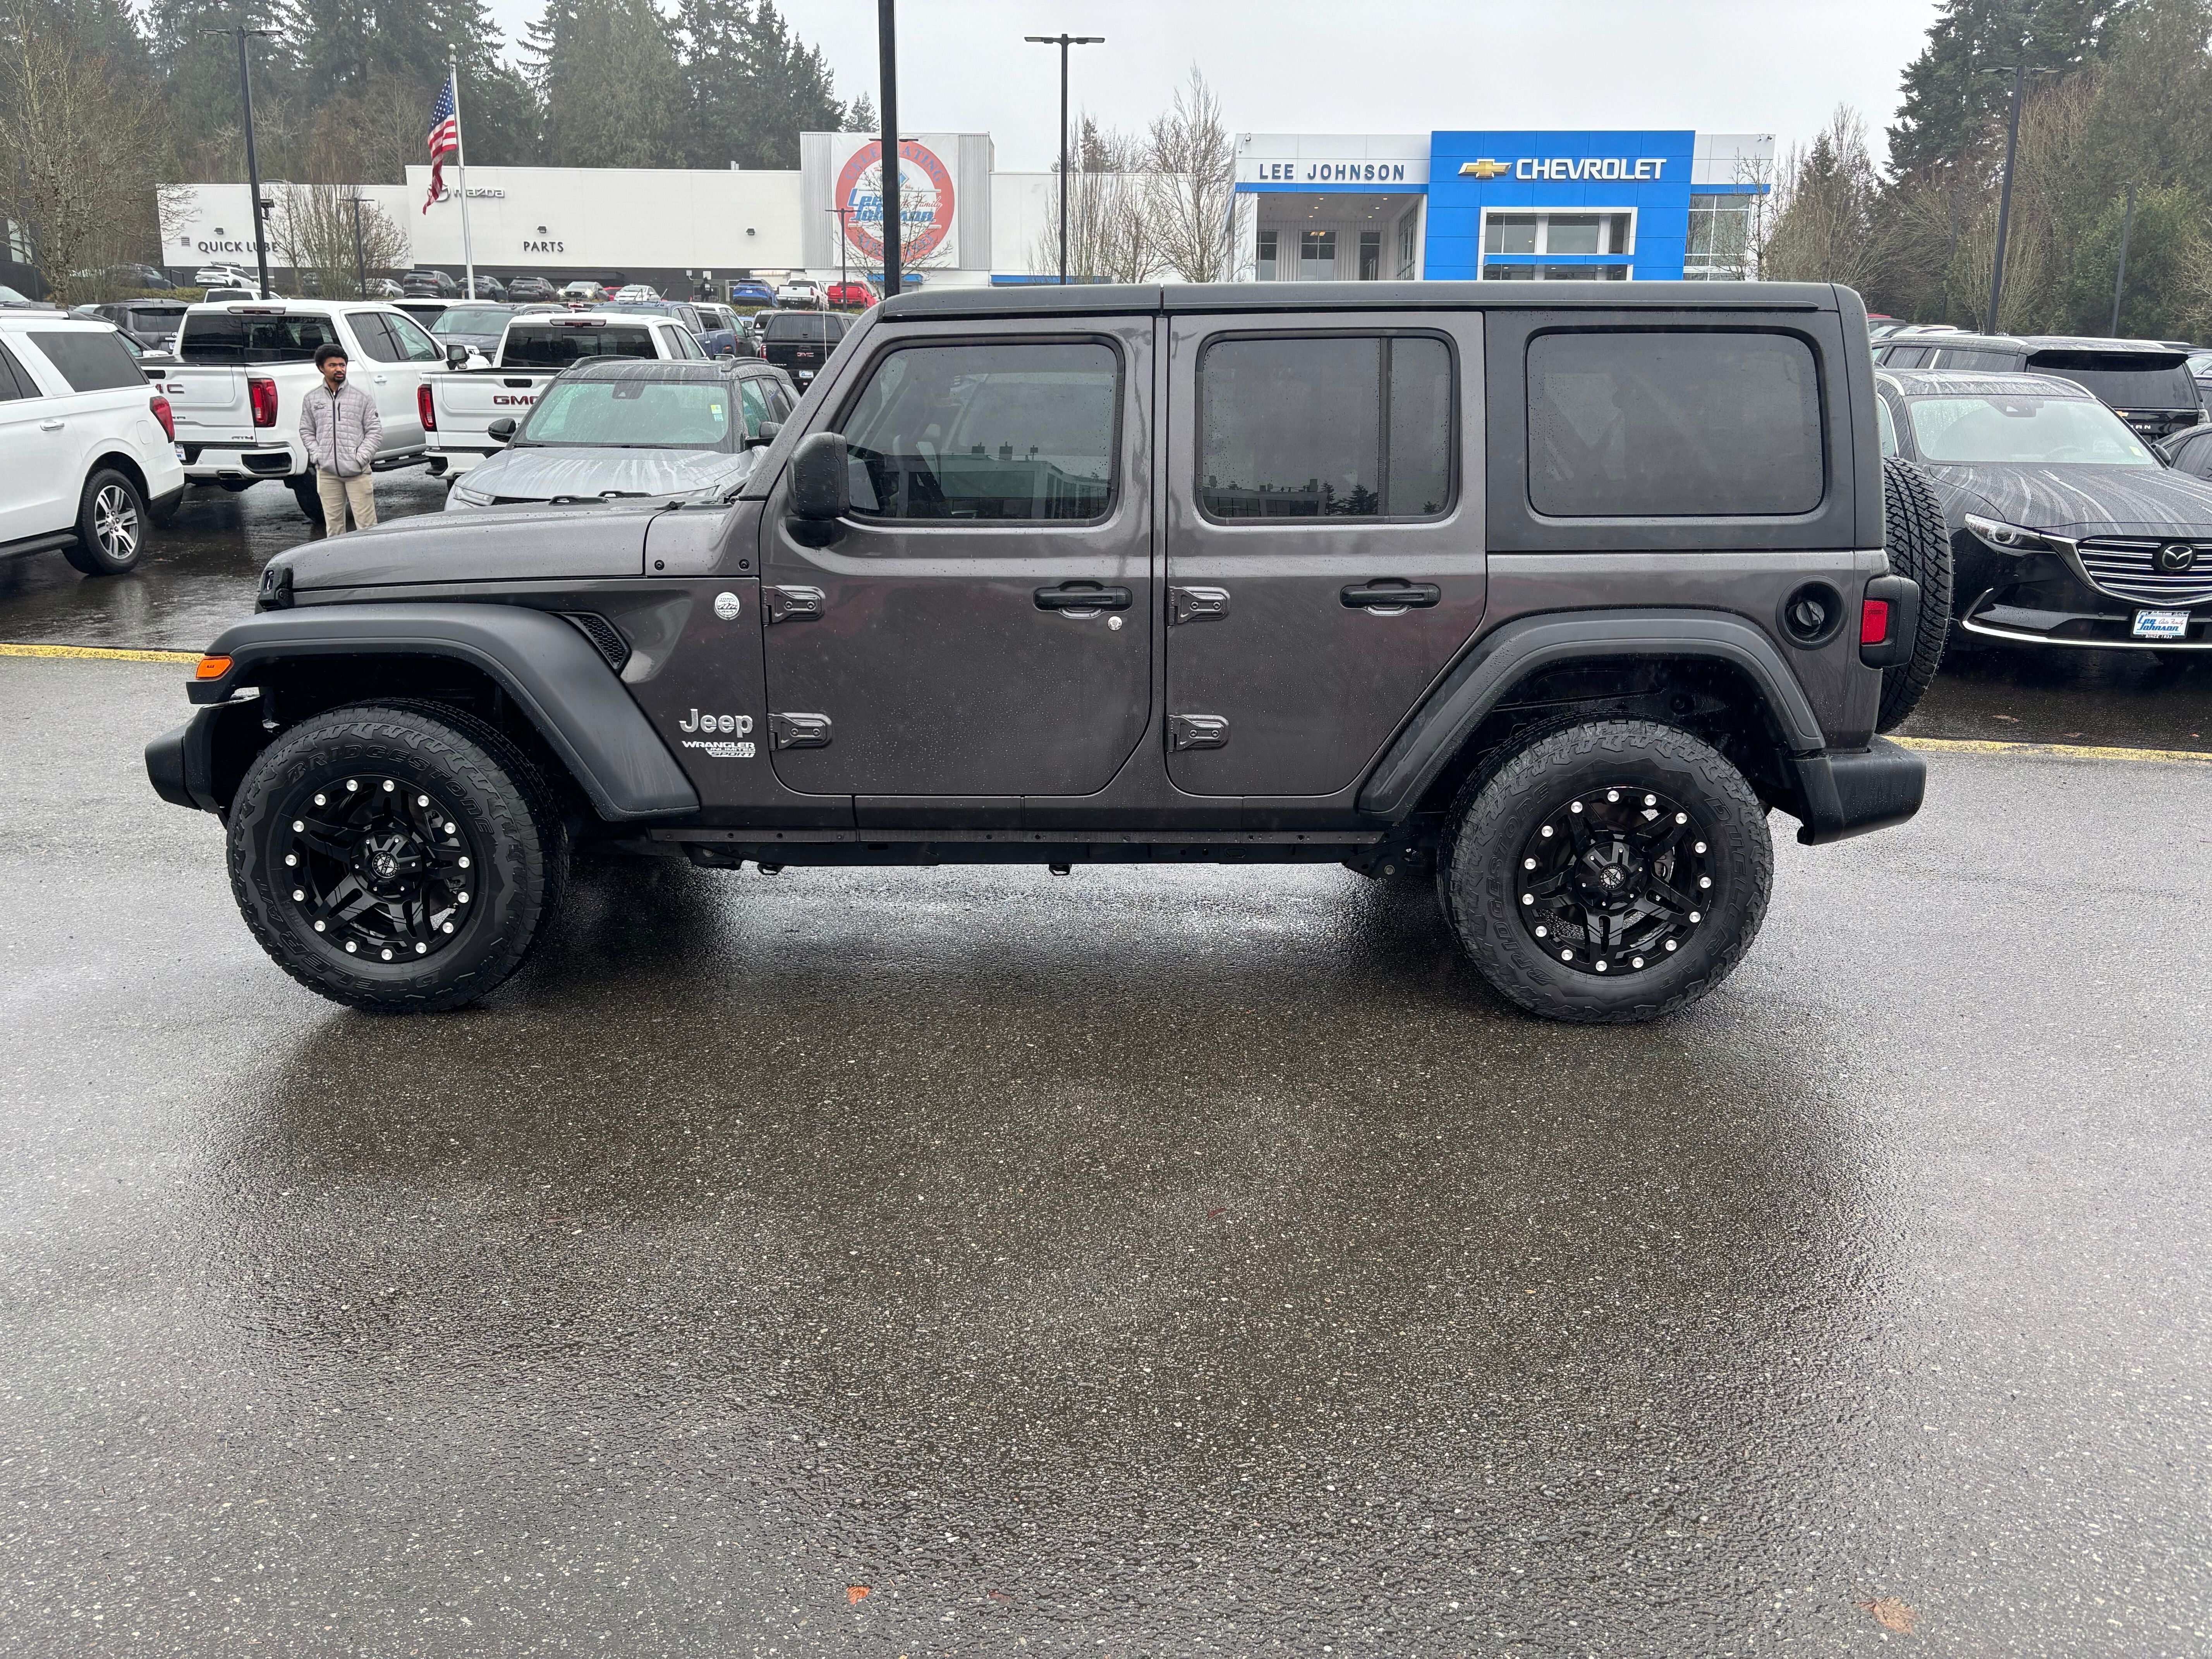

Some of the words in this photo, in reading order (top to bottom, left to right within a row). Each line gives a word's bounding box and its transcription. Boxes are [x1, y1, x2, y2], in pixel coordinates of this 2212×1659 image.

[845, 145, 945, 181] CELEATING
[1259, 164, 1294, 179] LEE
[1308, 164, 1405, 180] JOHNSON
[1516, 158, 1667, 179] CHEVROLET
[198, 242, 243, 254] QUICK
[524, 241, 563, 252] PARTS
[2137, 621, 2179, 631] Johnson
[2138, 615, 2157, 624] Lee
[679, 709, 753, 738] Jeep
[285, 744, 494, 834] BRIDGESTONE
[381, 855, 391, 875] OUTLAW
[1486, 780, 1551, 986] BRIDGESTONE
[1604, 869, 1621, 884] OUTLAW
[1704, 797, 1748, 957] DUELER
[280, 930, 440, 992] DUELER
